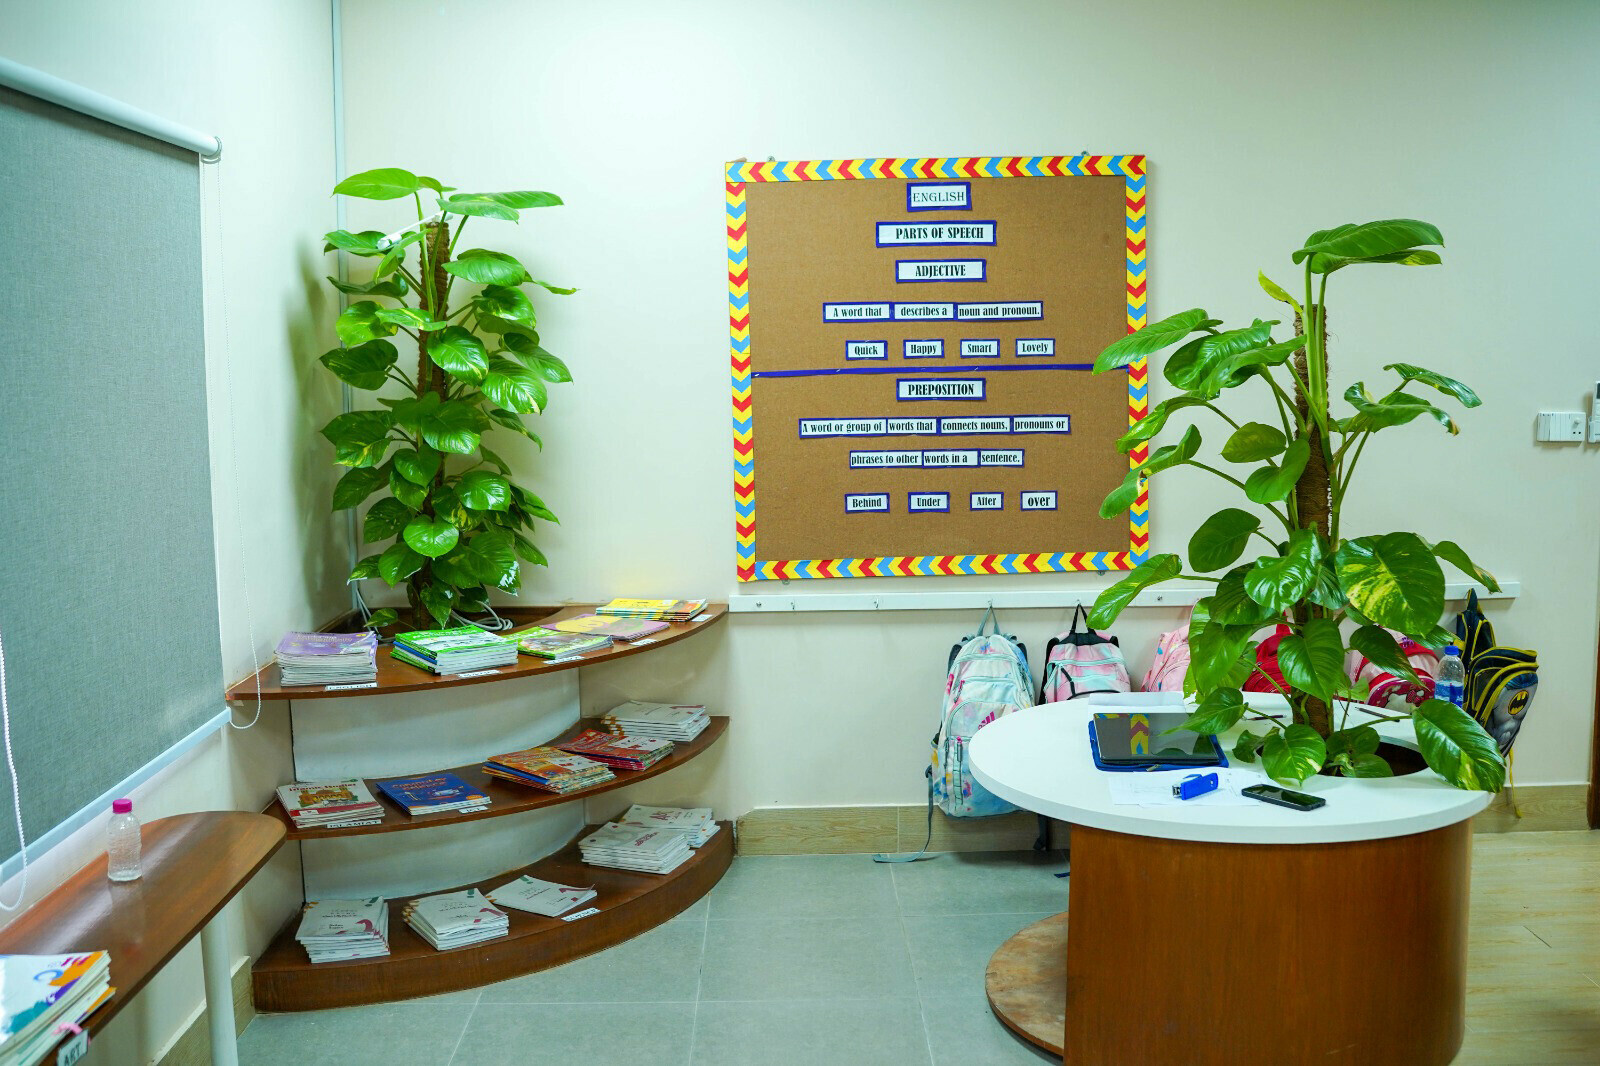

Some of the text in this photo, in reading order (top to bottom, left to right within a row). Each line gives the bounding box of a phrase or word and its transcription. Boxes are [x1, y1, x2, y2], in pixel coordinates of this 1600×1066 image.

[912, 191, 965, 203] ENGLISH
[895, 226, 984, 239] PARTS OF SPEECH
[915, 264, 966, 277] ADJECTIVE
[833, 305, 1040, 318] A word that describes a noun and pronoun.
[854, 345, 878, 356] Quick
[910, 344, 937, 355] Happy
[967, 343, 992, 353] Smart
[1021, 342, 1049, 353] Lovely
[907, 383, 974, 396] PREPOSITION
[802, 420, 1065, 434] A word or group of words that connects nouns, pronouns or
[851, 453, 1020, 466] phrases to other words in a sentence.
[852, 497, 882, 508] Behind
[916, 497, 941, 507] Under
[976, 496, 997, 506] After
[1027, 496, 1051, 507] over
[64, 1041, 82, 1066] ART
